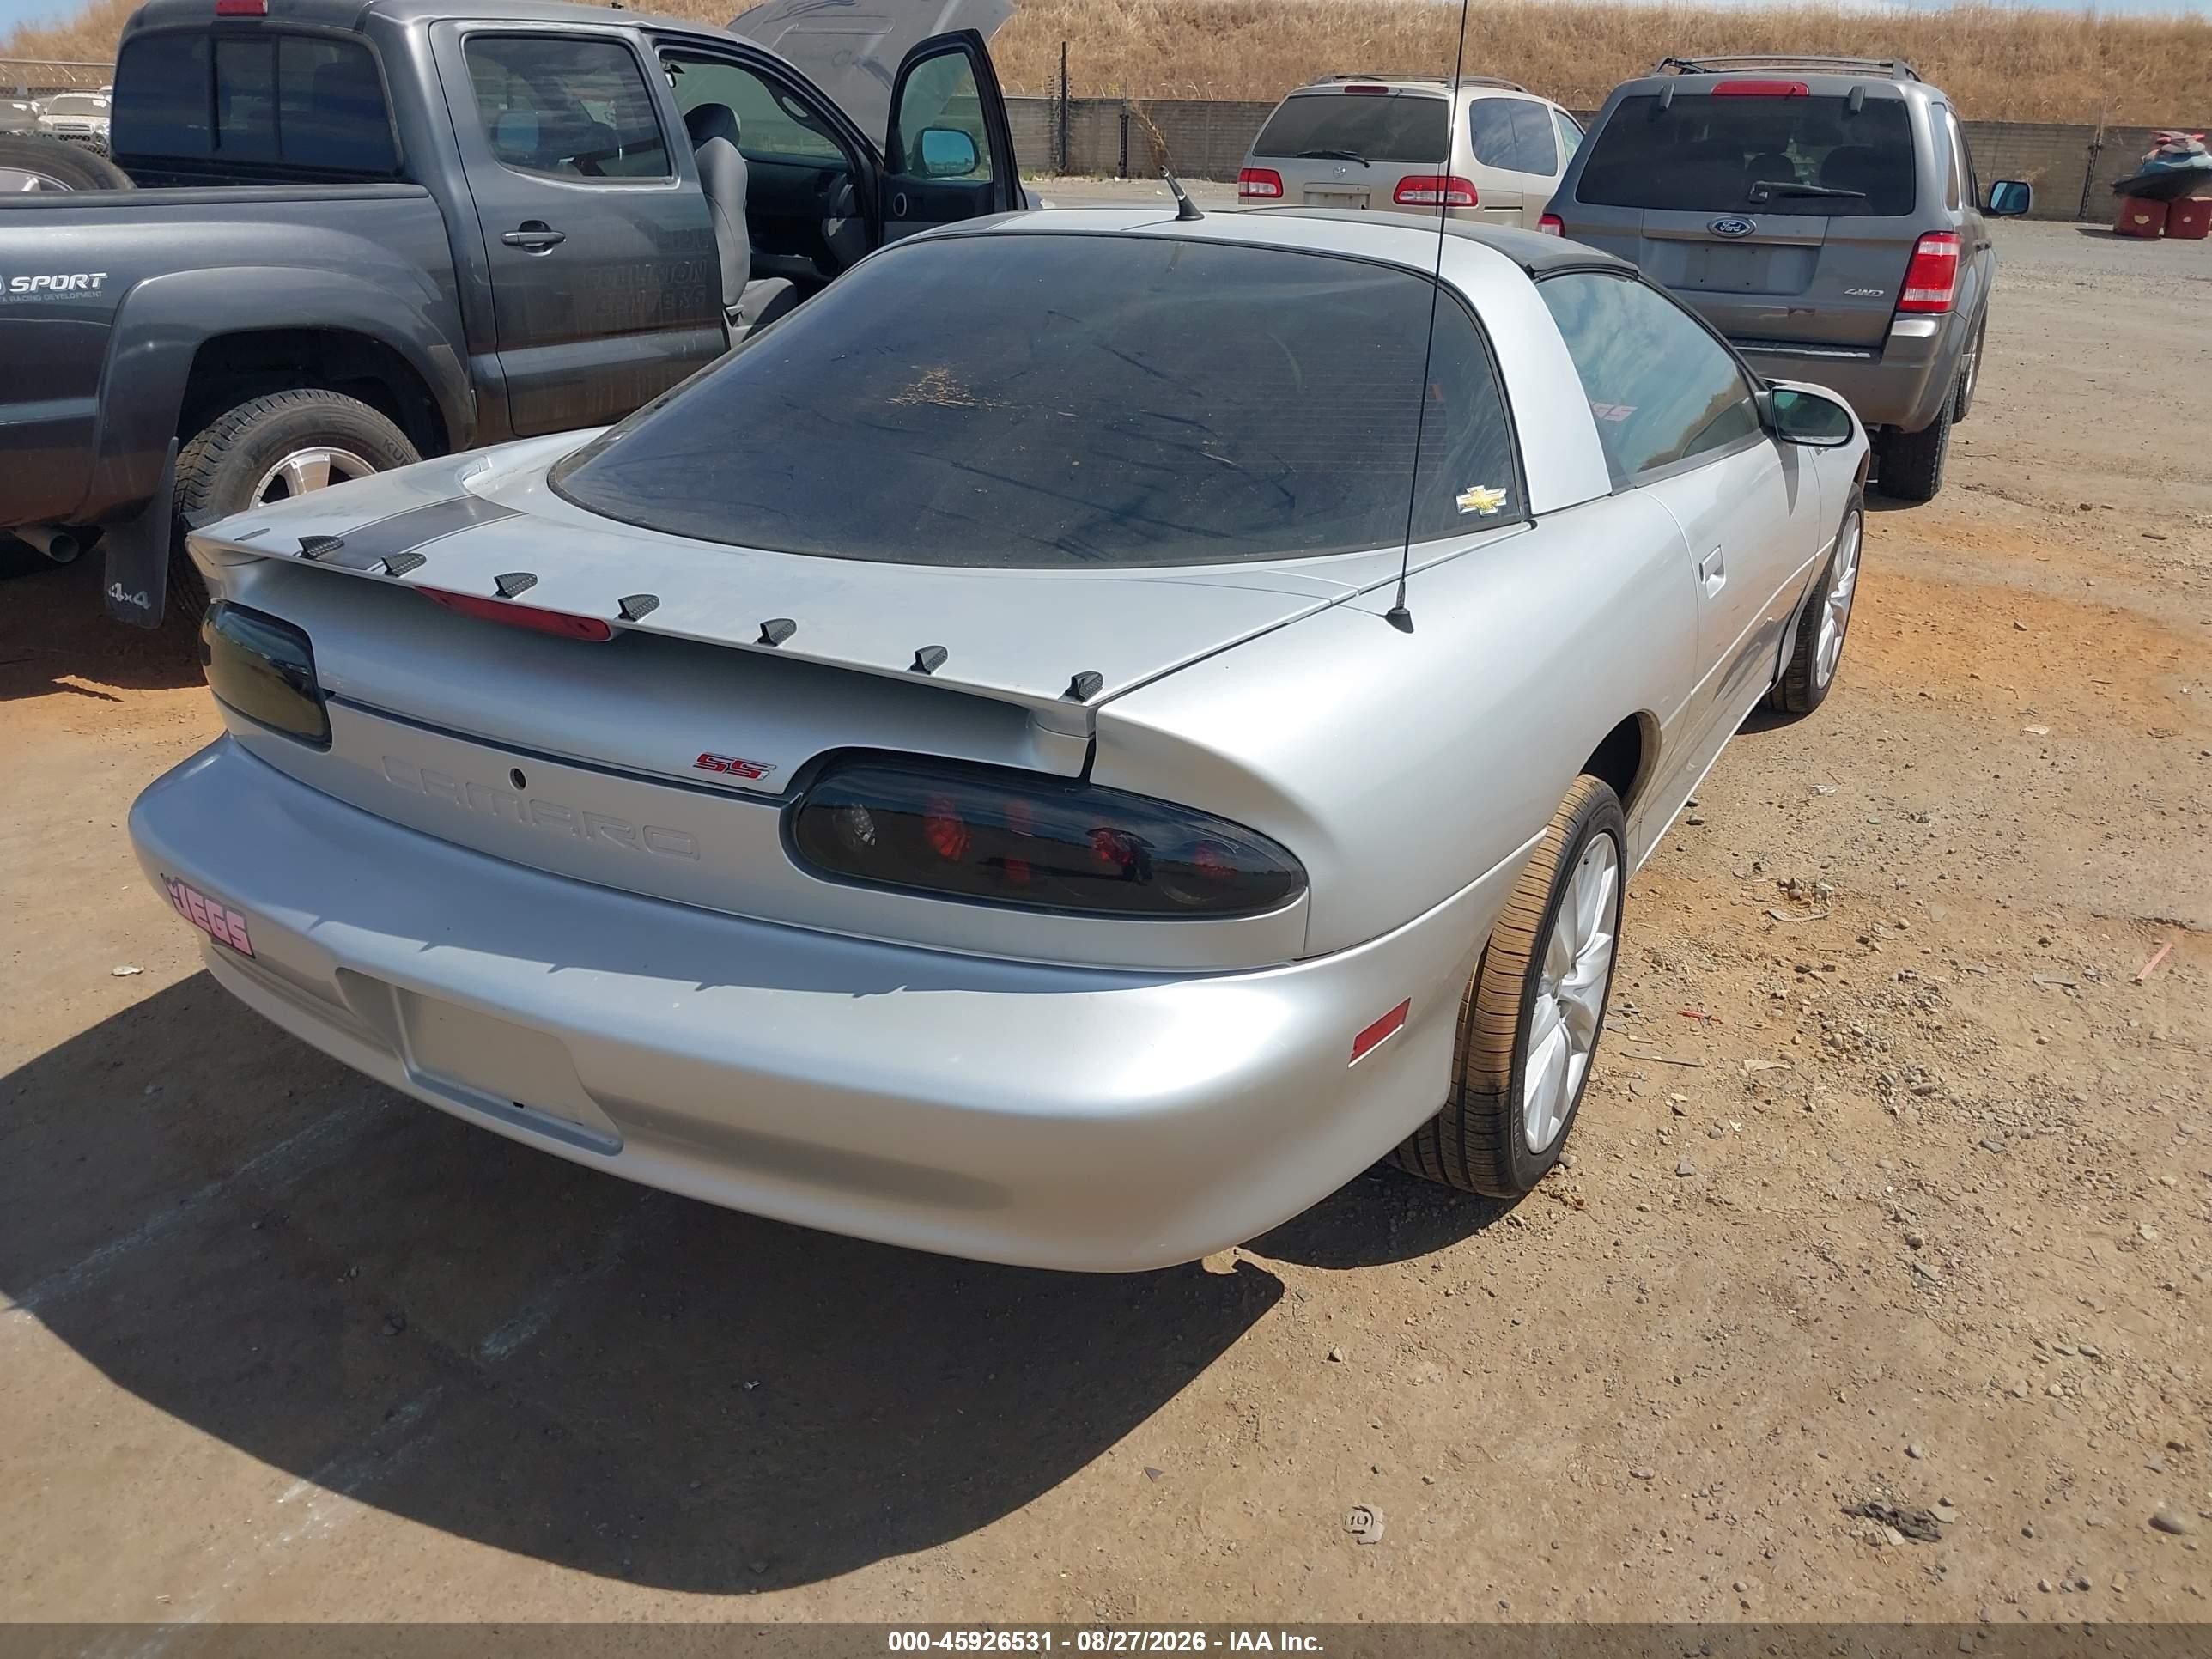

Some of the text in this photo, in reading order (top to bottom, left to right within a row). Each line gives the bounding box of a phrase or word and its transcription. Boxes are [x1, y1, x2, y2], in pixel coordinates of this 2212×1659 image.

[9, 272, 108, 294] SPORT
[43, 290, 102, 301] DEVELOPMENT
[1844, 288, 1885, 297] 4WD
[108, 582, 152, 610] 4x4
[692, 752, 777, 781] SS
[381, 755, 701, 861] CAMARO
